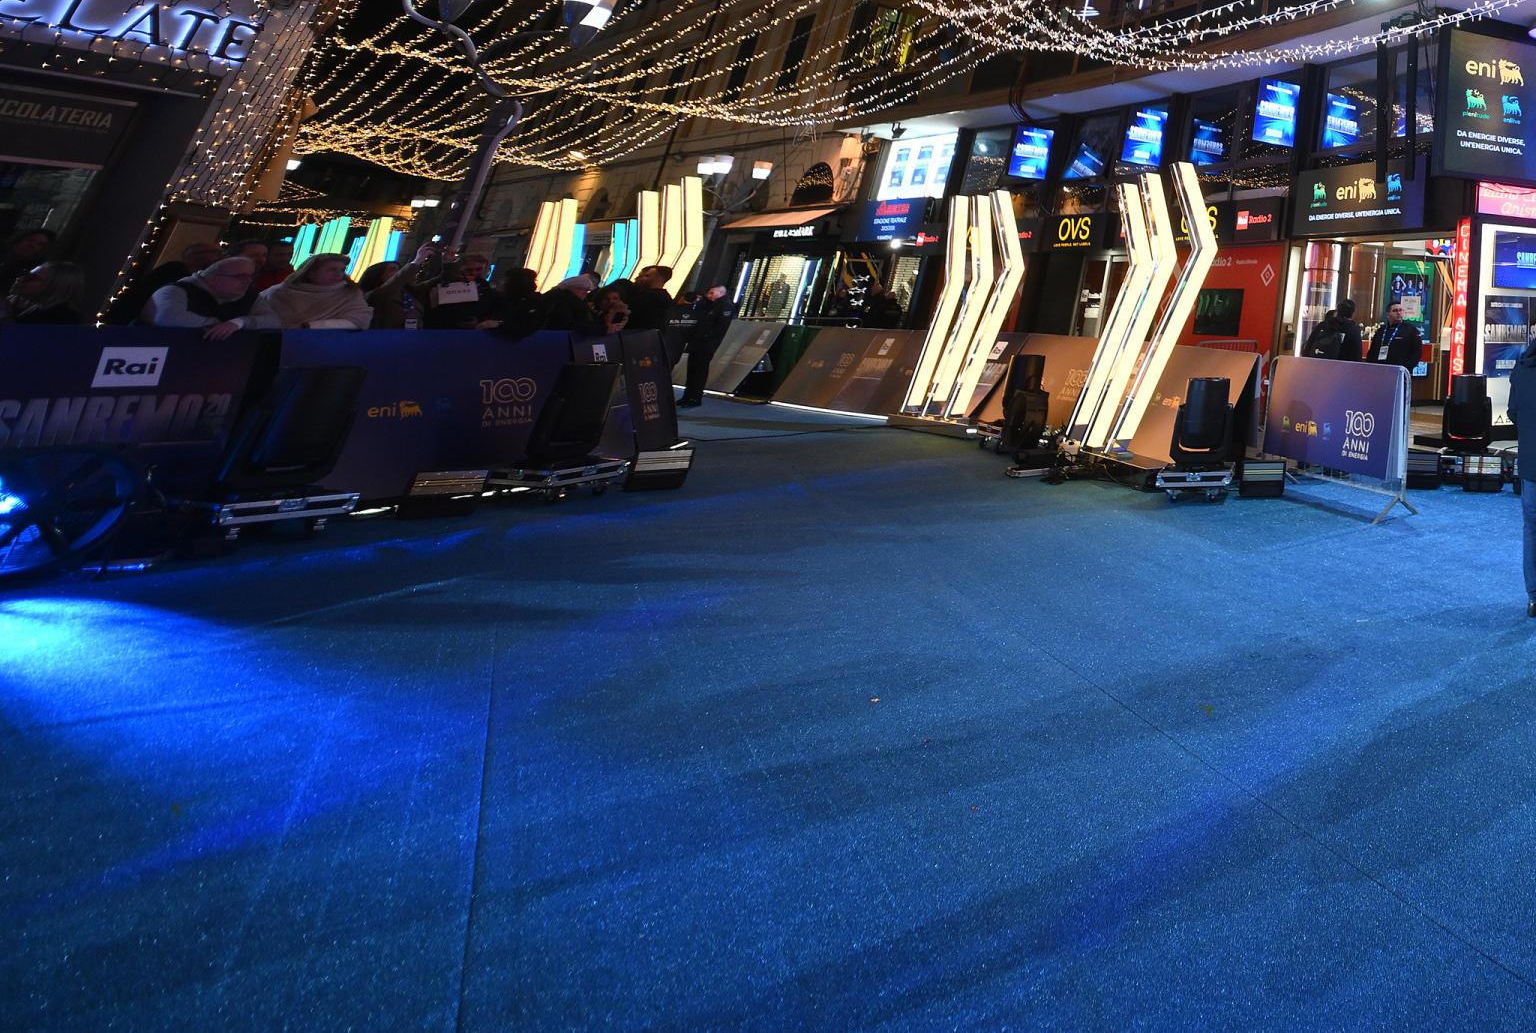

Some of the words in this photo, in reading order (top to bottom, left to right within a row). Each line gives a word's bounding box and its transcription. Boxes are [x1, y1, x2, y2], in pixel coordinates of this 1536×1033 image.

[1465, 59, 1496, 79] eni
[0, 98, 113, 128] COLATERIA
[1457, 130, 1468, 138] DA
[1468, 131, 1497, 142] ENERGIE
[1497, 135, 1526, 147] DIVERSE,
[1501, 146, 1523, 155] UNICA.
[1336, 180, 1358, 201] eni
[1248, 214, 1268, 224] Radio
[1267, 214, 1273, 222] 2
[1316, 213, 1335, 221] ENERGIE
[1058, 216, 1091, 241] OVS
[1457, 226, 1471, 307] CINEMA
[1485, 323, 1522, 342] SANREMO
[1452, 318, 1466, 375] ARIS
[103, 357, 160, 376] Rai
[480, 377, 537, 404] 100
[367, 402, 398, 418] eni
[482, 405, 533, 419] ANNI
[1295, 420, 1309, 434] eni
[1345, 410, 1375, 438] 100
[1342, 437, 1369, 454] ANNI
[1348, 452, 1369, 461] ENERGIA
